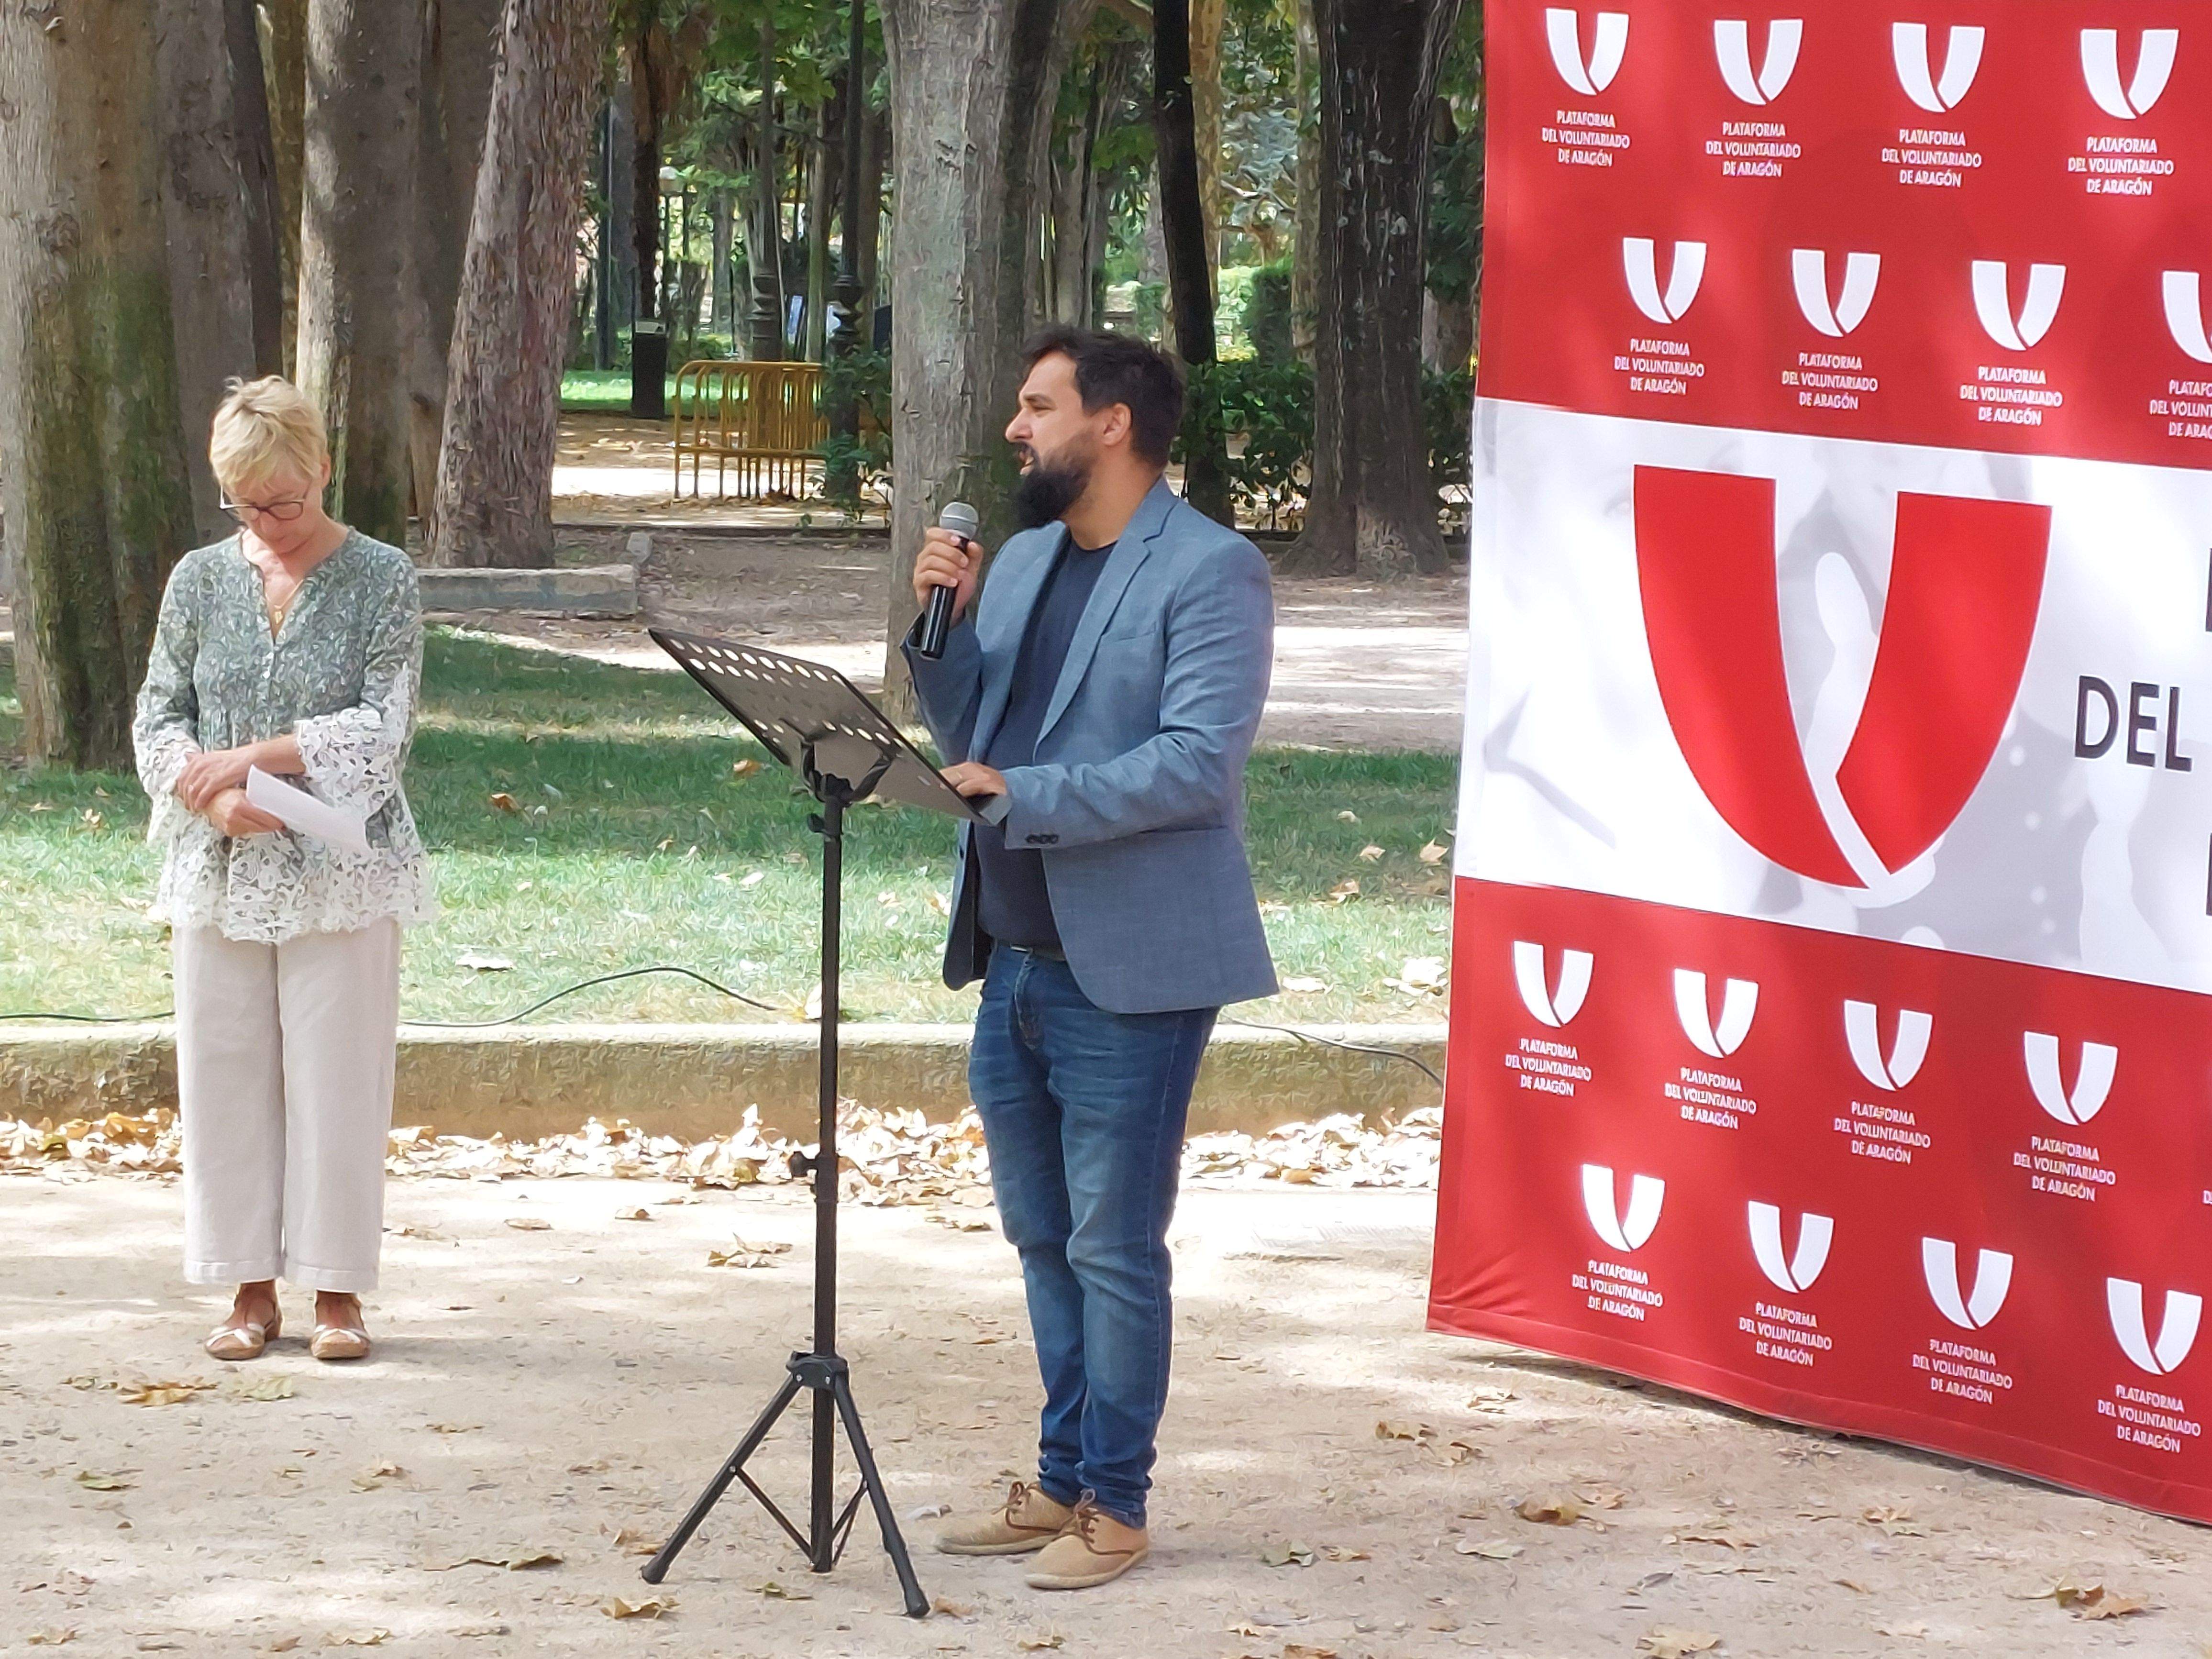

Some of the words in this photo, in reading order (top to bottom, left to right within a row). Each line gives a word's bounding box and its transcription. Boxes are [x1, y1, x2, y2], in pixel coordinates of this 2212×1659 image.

[1556, 110, 1615, 128] PLATAFORMA
[1722, 122, 1786, 137] PLATAFORMA
[1542, 127, 1558, 143] DEL
[1559, 130, 1630, 149] VOLUNTARIADO
[1899, 129, 1966, 146] PLATAFORMA
[2086, 136, 2157, 153] PLATAFORMA
[1558, 148, 1570, 164] DE
[1571, 149, 1613, 166] ARAGÓN
[1705, 141, 1724, 155] DEL
[1725, 142, 1801, 158] VOLUNTARIADO
[1881, 148, 1900, 163] DEL
[1901, 149, 1982, 167] VOLUNTARIADO
[1723, 160, 1736, 176] DE
[1737, 160, 1782, 177] ARAGÓN
[2068, 157, 2088, 172] DEL
[2088, 157, 2174, 175] VOLUNTARIADO
[1899, 169, 1913, 184] DE
[1914, 168, 1961, 188] ARAGÓN
[2086, 178, 2101, 193] DE
[2101, 177, 2152, 195] ARAGÓN
[1630, 338, 1690, 356] PLATAFORMA
[1614, 356, 1630, 370] DEL
[1632, 357, 1704, 377] VOLUNTARIADO
[1799, 352, 1862, 370] PLATAFORMA
[1630, 376, 1644, 391] DE
[1644, 377, 1686, 395] ARAGÓN
[1781, 370, 1800, 385] DEL
[1801, 372, 1878, 392] VOLUNTARIADO
[1978, 365, 2046, 385] PLATAFORMA
[1799, 391, 1813, 407] DE
[1813, 392, 1858, 409] ARAGÓN
[1960, 385, 1979, 401] DEL
[1980, 387, 2063, 407] VOLUNTARIADO
[2149, 399, 2169, 415] DEL
[1978, 406, 1992, 422] DE
[1993, 407, 2042, 426] ARAGÓN
[2168, 421, 2184, 437] DE
[2075, 675, 2192, 772] DEL
[1519, 1038, 1578, 1060] PLATAFORMA
[1505, 1054, 1523, 1070] DEL
[1522, 1056, 1592, 1082] VOLUNTARIADO
[1680, 1066, 1742, 1092] PLATAFORMA
[1520, 1074, 1533, 1089] DE
[1533, 1076, 1574, 1096] ARAGÓN
[1664, 1082, 1682, 1100] DEL
[1682, 1086, 1757, 1115] VOLUNTARIADO
[1680, 1105, 1694, 1121] DE
[1694, 1108, 1738, 1129] ARAGÓN
[1851, 1101, 1915, 1126] PLATAFORMA
[1834, 1117, 1852, 1133] DEL
[1853, 1120, 1931, 1148] VOLUNTARIADO
[1851, 1140, 1865, 1155] DE
[1865, 1143, 1911, 1164] ARAGÓN
[2031, 1136, 2100, 1162] PLATAFORMA
[2013, 1152, 2032, 1168] DEL
[2034, 1156, 2116, 1185] VOLUNTARIADO
[2032, 1175, 2046, 1191] DE
[2047, 1179, 2095, 1201] ARAGÓN
[1588, 1260, 1648, 1285] PLATAFORMA
[1572, 1274, 1589, 1290] DEL
[1590, 1278, 1663, 1307] VOLUNTARIADO
[1587, 1295, 1601, 1310] DE
[1602, 1299, 1645, 1321] ARAGÓN
[1755, 1301, 1817, 1327] PLATAFORMA
[1739, 1316, 1757, 1334] DEL
[1757, 1321, 1832, 1350] VOLUNTARIADO
[1756, 1340, 1770, 1357] DE
[1770, 1344, 1814, 1366] ARAGÓN
[1929, 1338, 1996, 1366] PLATAFORMA
[1913, 1354, 1930, 1371] DEL
[1932, 1359, 2013, 1389] VOLUNTARIADO
[1931, 1377, 1944, 1392] DE
[1945, 1381, 1992, 1404] ARAGÓN
[2115, 1384, 2184, 1413] PLATAFORMA
[2098, 1399, 2116, 1417] DEL
[2118, 1405, 2201, 1437] VOLUNTARIADO
[2117, 1425, 2131, 1441] DE
[2132, 1429, 2180, 1453] ARAGÓN
